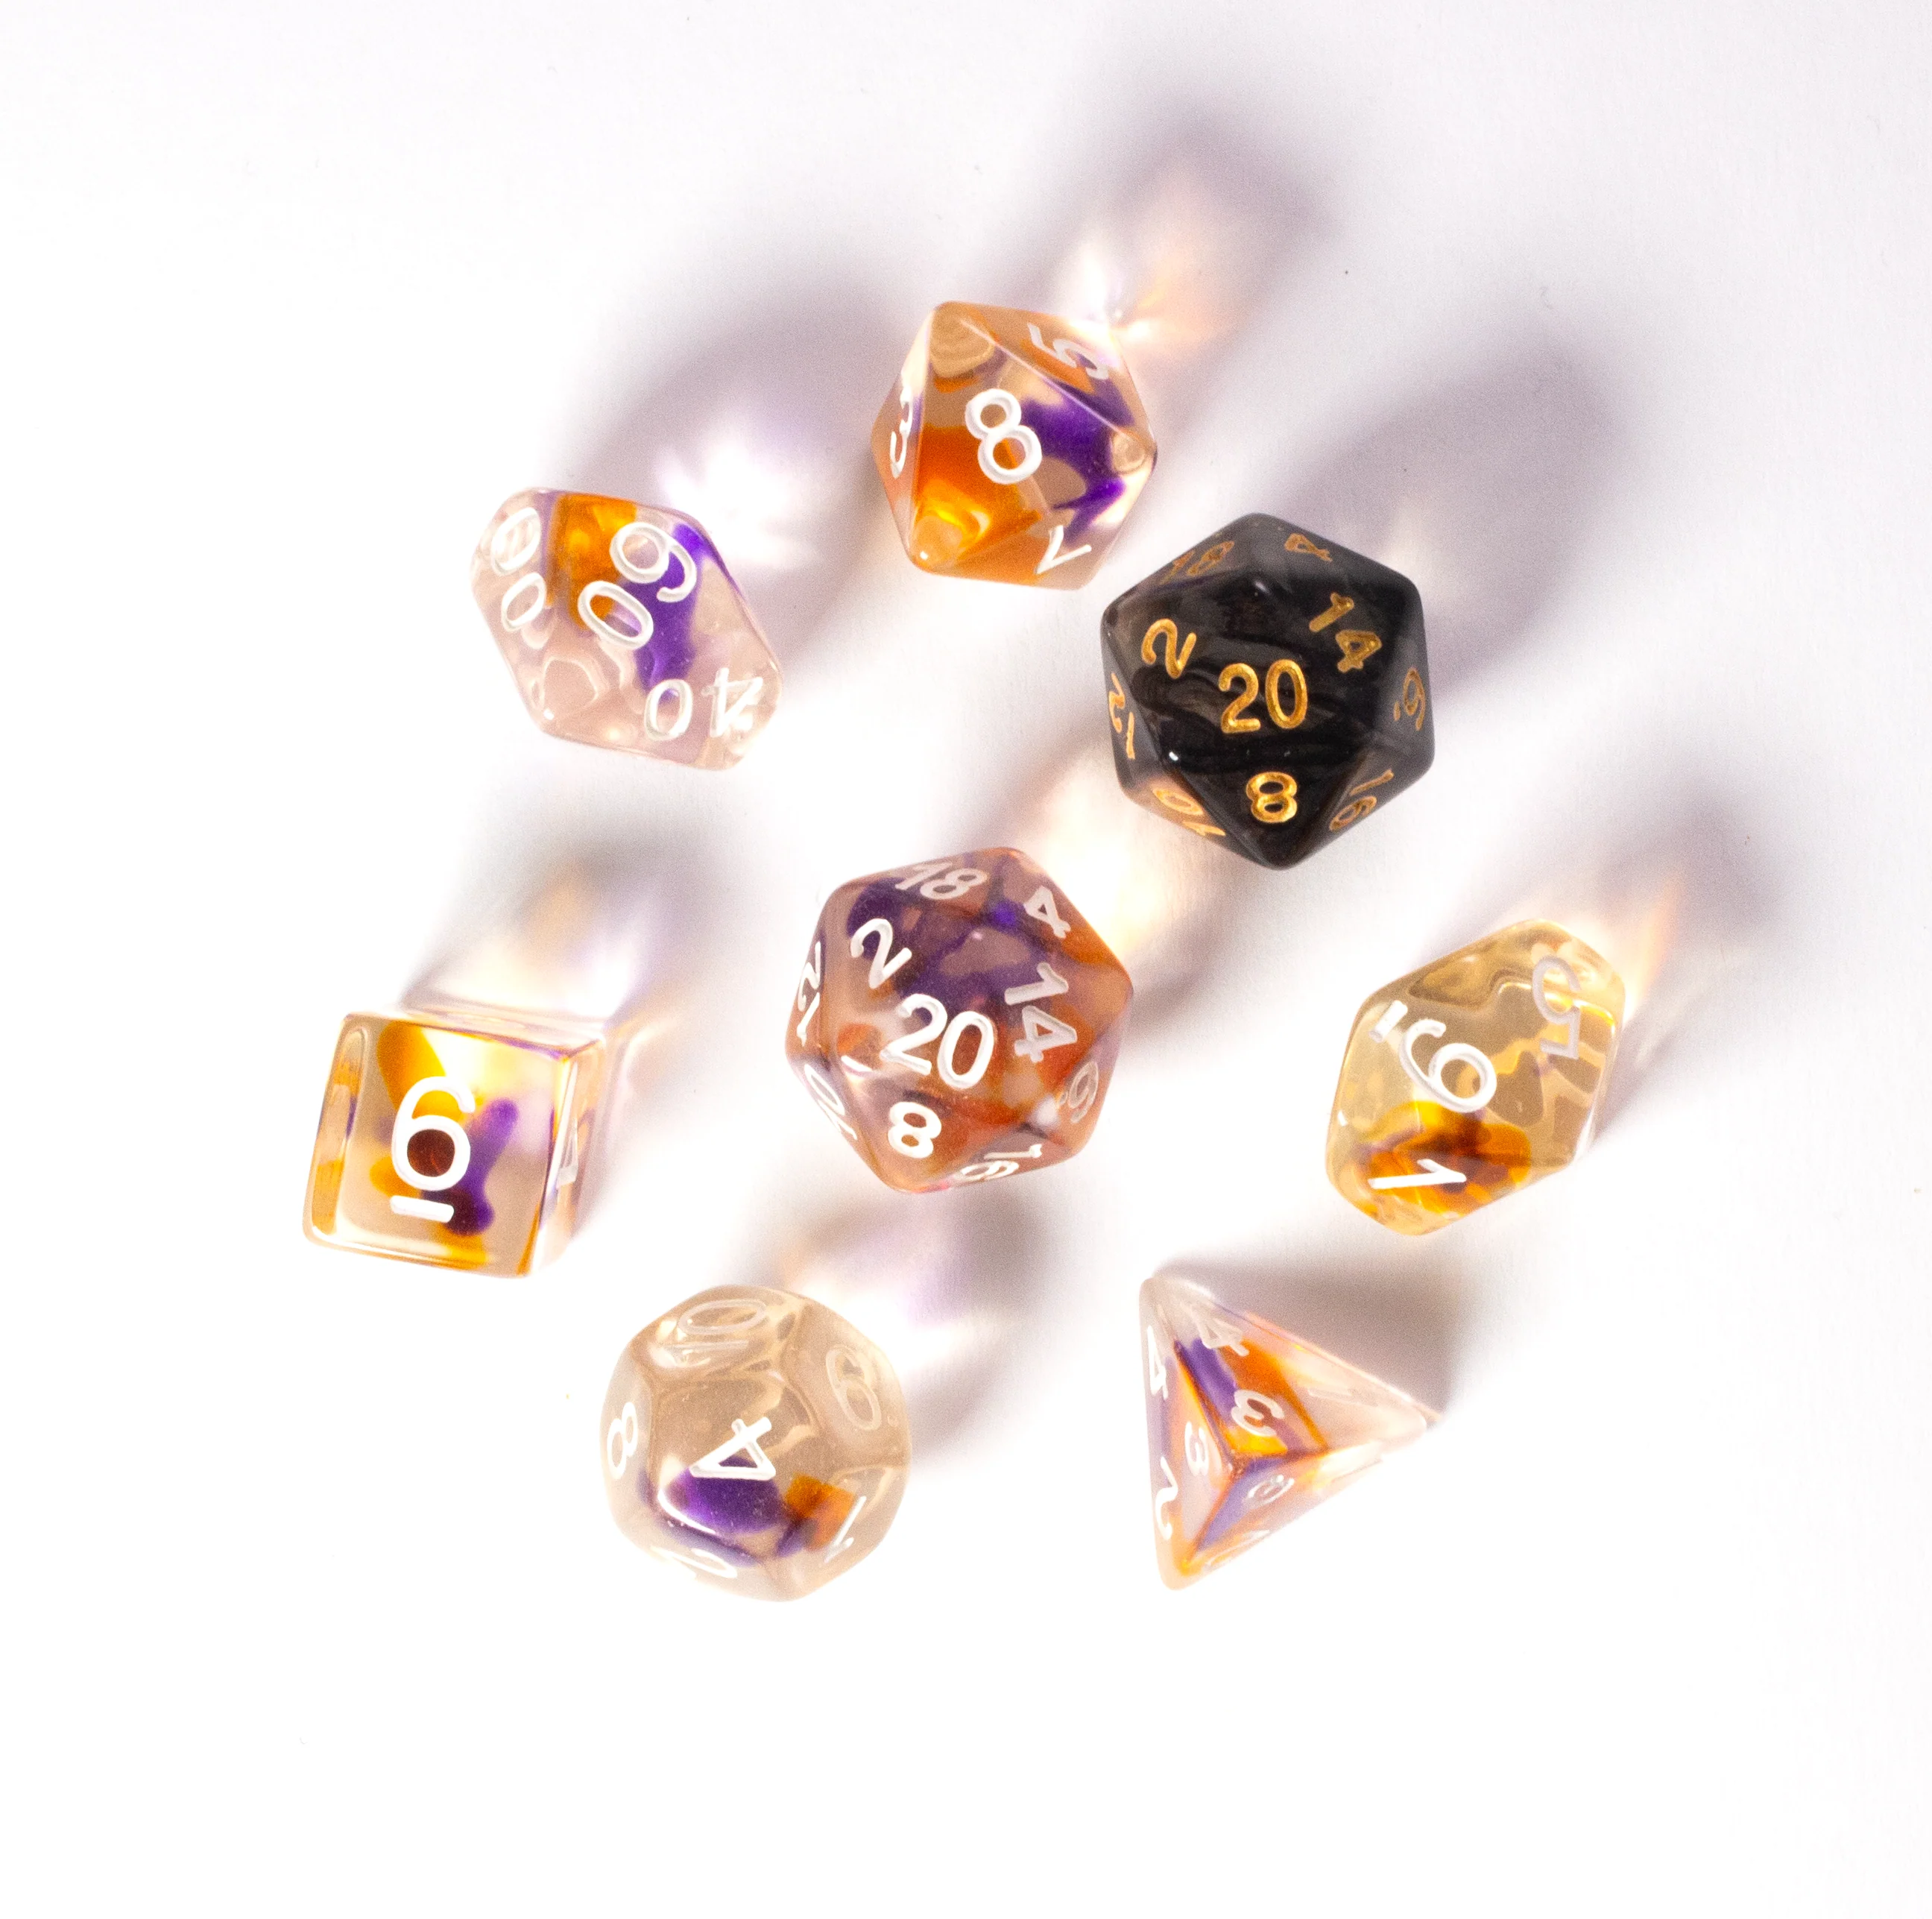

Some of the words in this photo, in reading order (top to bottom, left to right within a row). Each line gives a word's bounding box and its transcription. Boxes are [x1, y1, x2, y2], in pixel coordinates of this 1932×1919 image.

[890, 384, 913, 479] 3
[965, 388, 1043, 485] 8
[1158, 540, 1235, 585] 18
[1284, 533, 1333, 562] 4
[1141, 618, 1197, 679] 2
[1309, 593, 1382, 672] 14
[644, 667, 764, 741] 40
[1108, 673, 1136, 760] 12
[1219, 659, 1308, 734] 20
[1246, 772, 1298, 823] 8
[895, 862, 988, 901] 18
[1023, 885, 1071, 939] 4
[850, 918, 912, 989] 2
[879, 993, 994, 1091] 20
[1004, 962, 1077, 1062] 14
[1532, 955, 1582, 1060] 5
[888, 1101, 942, 1159] 8
[607, 1401, 639, 1481] 8
[689, 1416, 777, 1481] 4
[1184, 1420, 1210, 1477] 3
[1231, 1388, 1285, 1437] 3
[1155, 1456, 1178, 1541] 2
